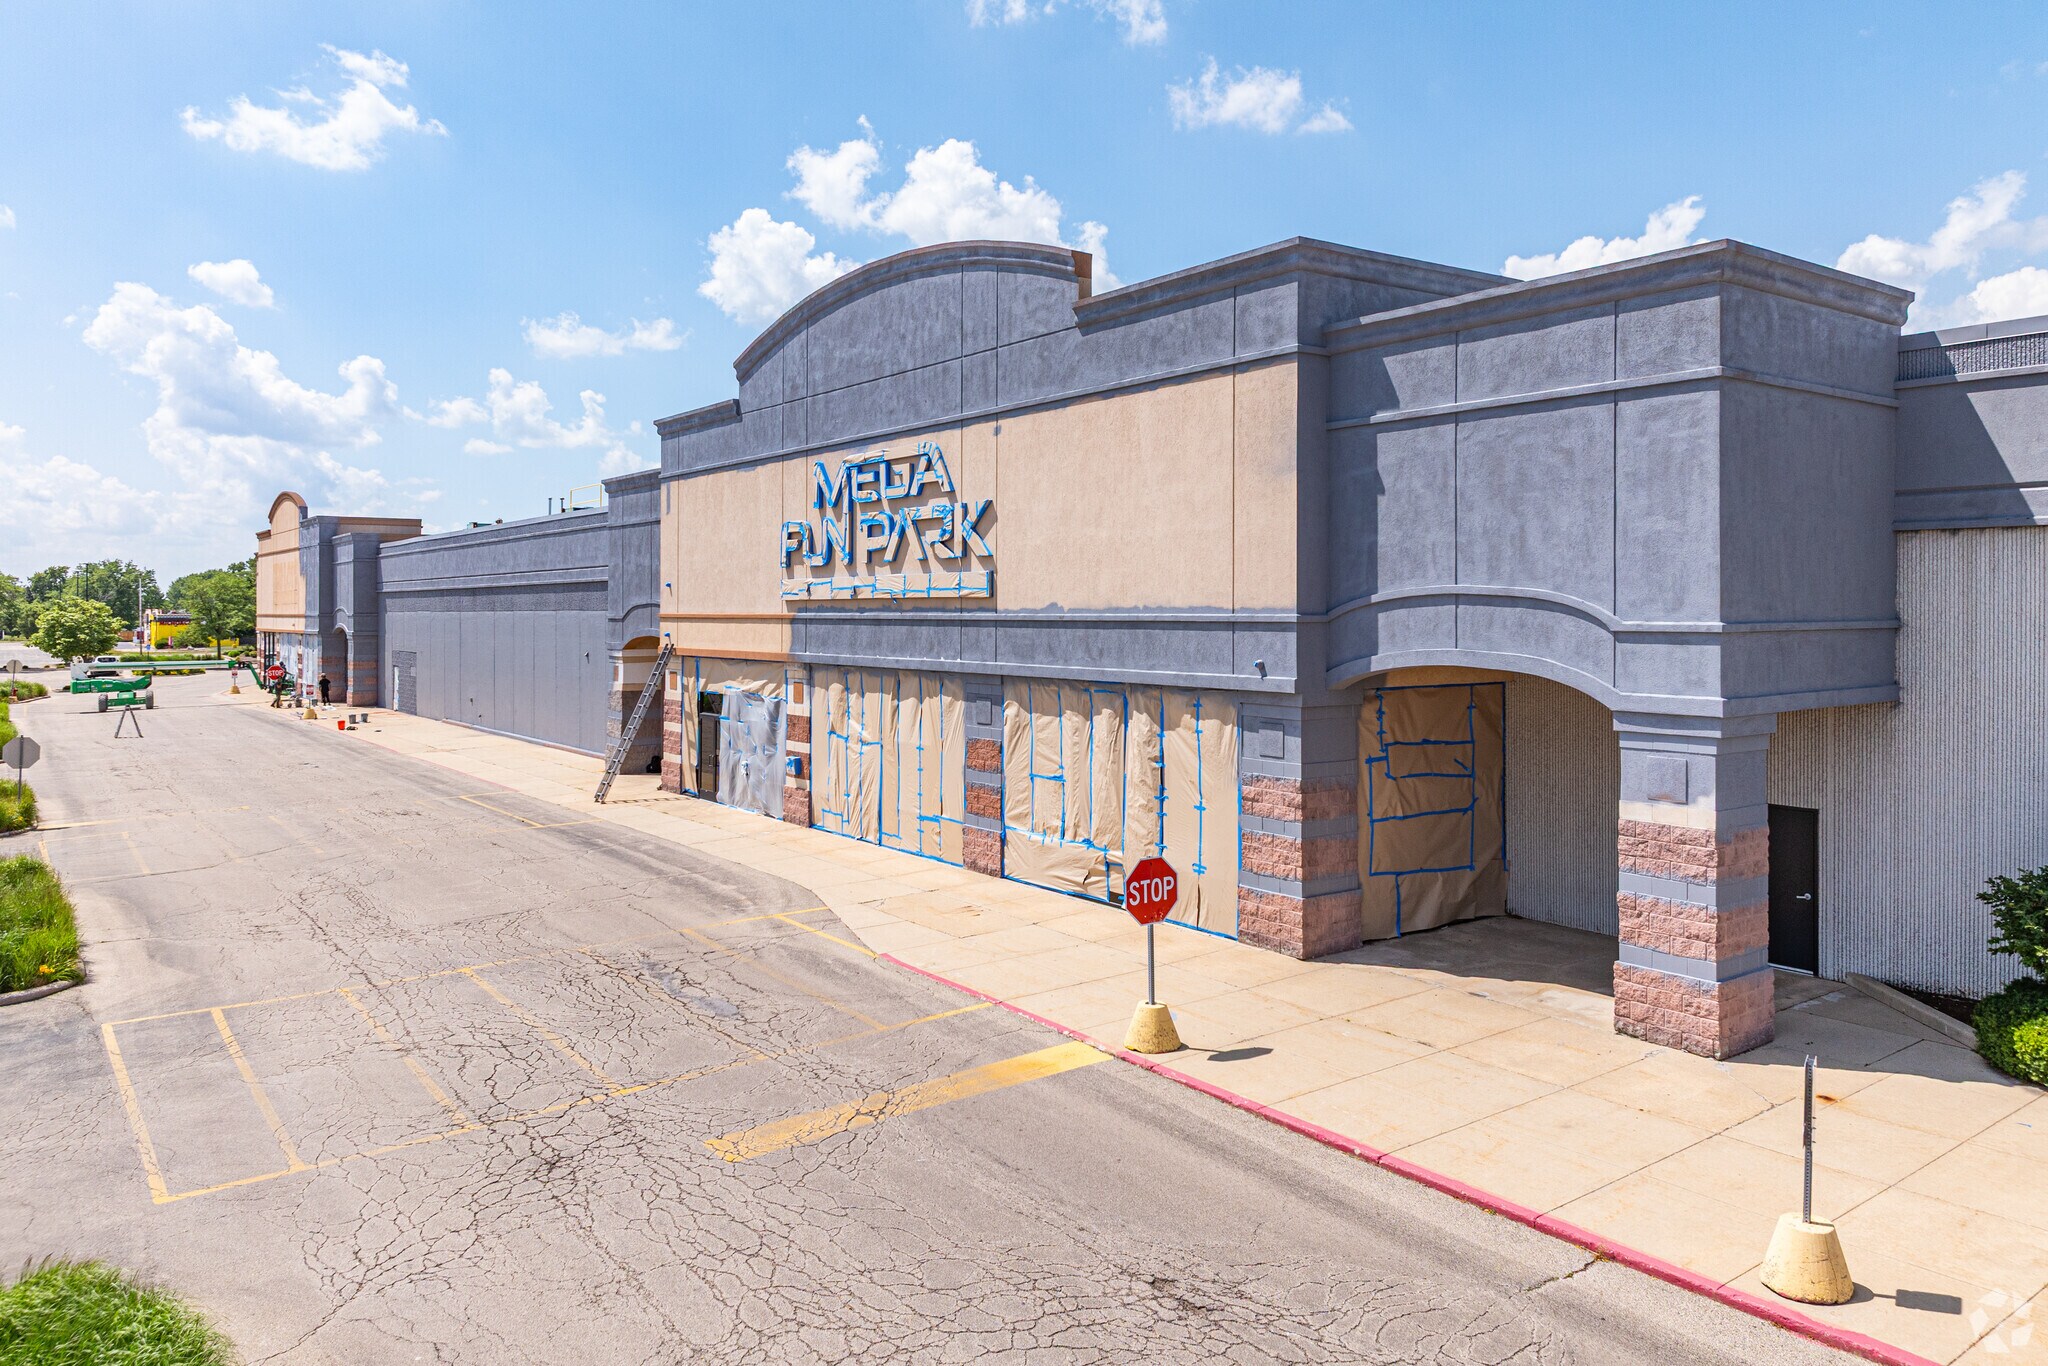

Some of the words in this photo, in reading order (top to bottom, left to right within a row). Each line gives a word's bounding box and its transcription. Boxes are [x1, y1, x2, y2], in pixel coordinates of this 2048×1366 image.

[860, 499, 993, 564] PARK
[268, 669, 283, 677] STOP
[1129, 876, 1175, 906] STOP
